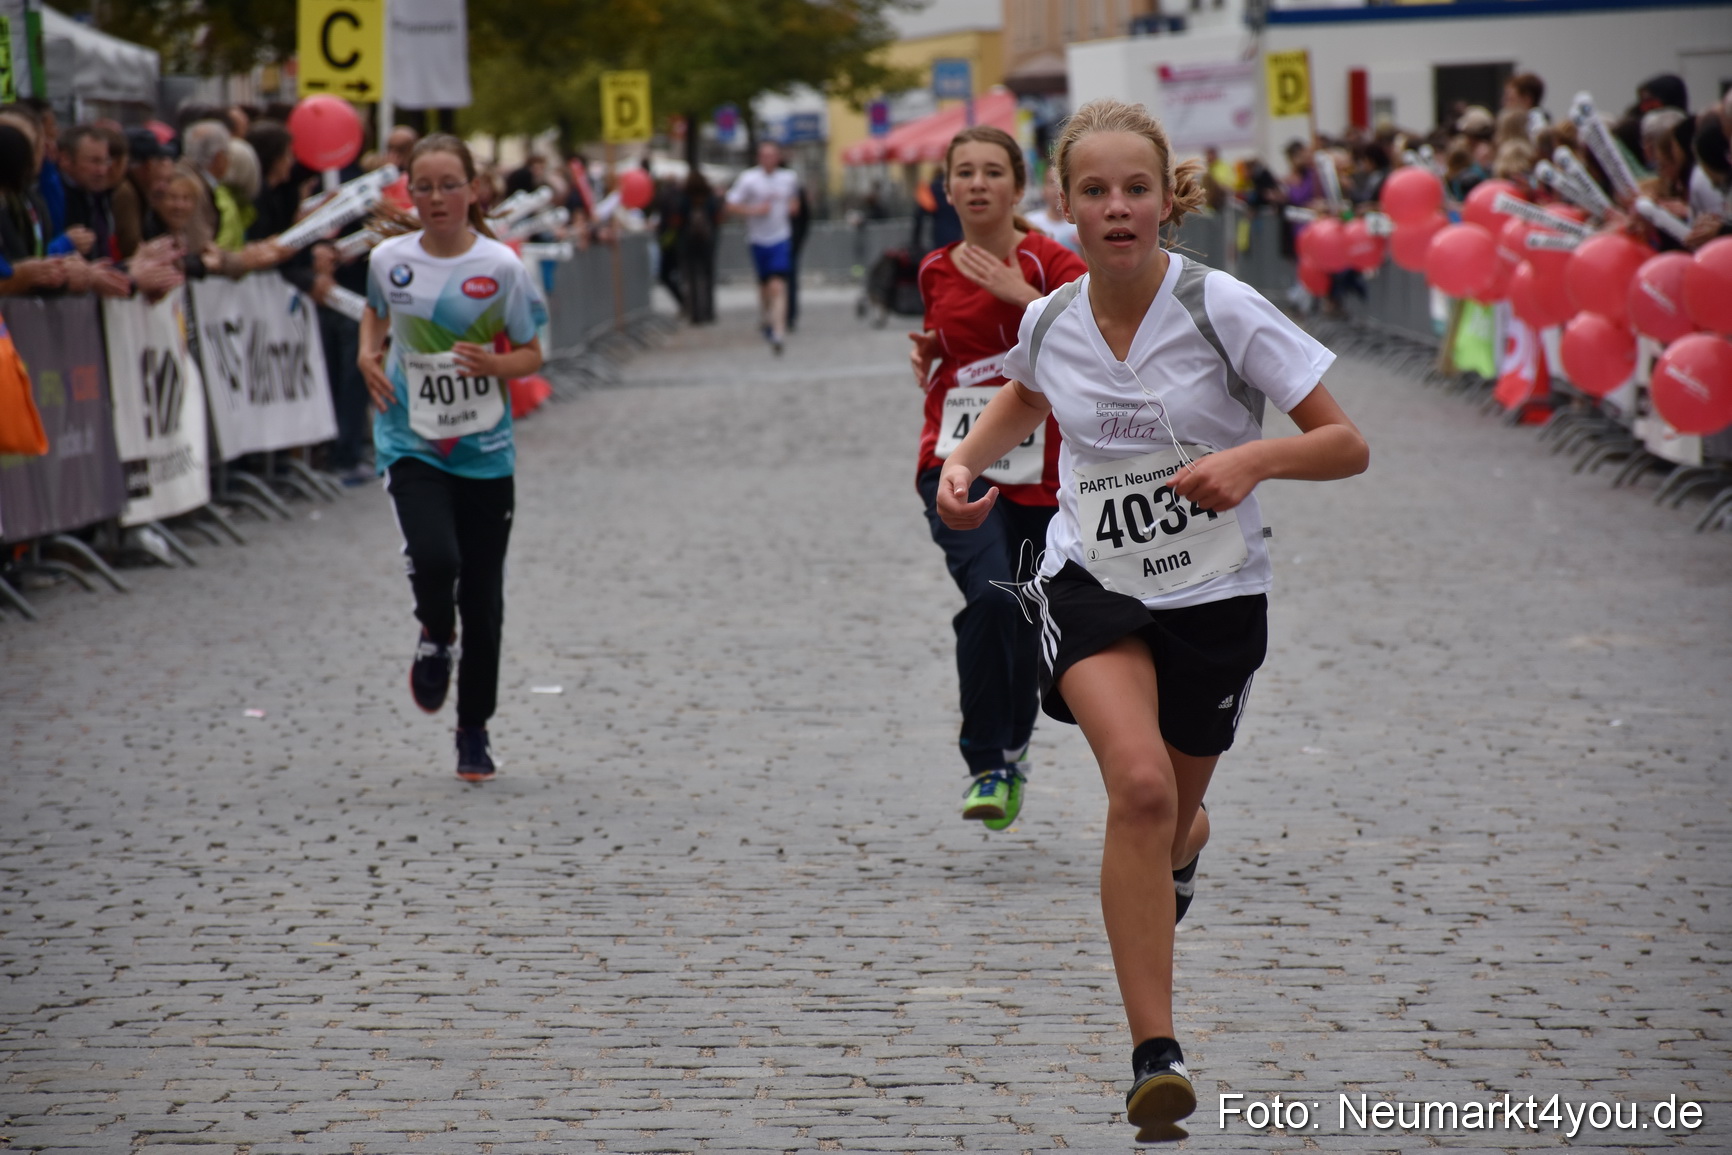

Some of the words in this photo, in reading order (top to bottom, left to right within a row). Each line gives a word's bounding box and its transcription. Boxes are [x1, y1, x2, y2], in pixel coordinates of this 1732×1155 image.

[320, 9, 361, 70] C
[1277, 70, 1304, 103] D
[615, 94, 641, 128] D
[946, 398, 976, 408] PARTL
[1096, 410, 1128, 418] Service
[1093, 401, 1164, 450] Julia
[1079, 475, 1123, 495] PARTL
[1142, 550, 1192, 578] Anna
